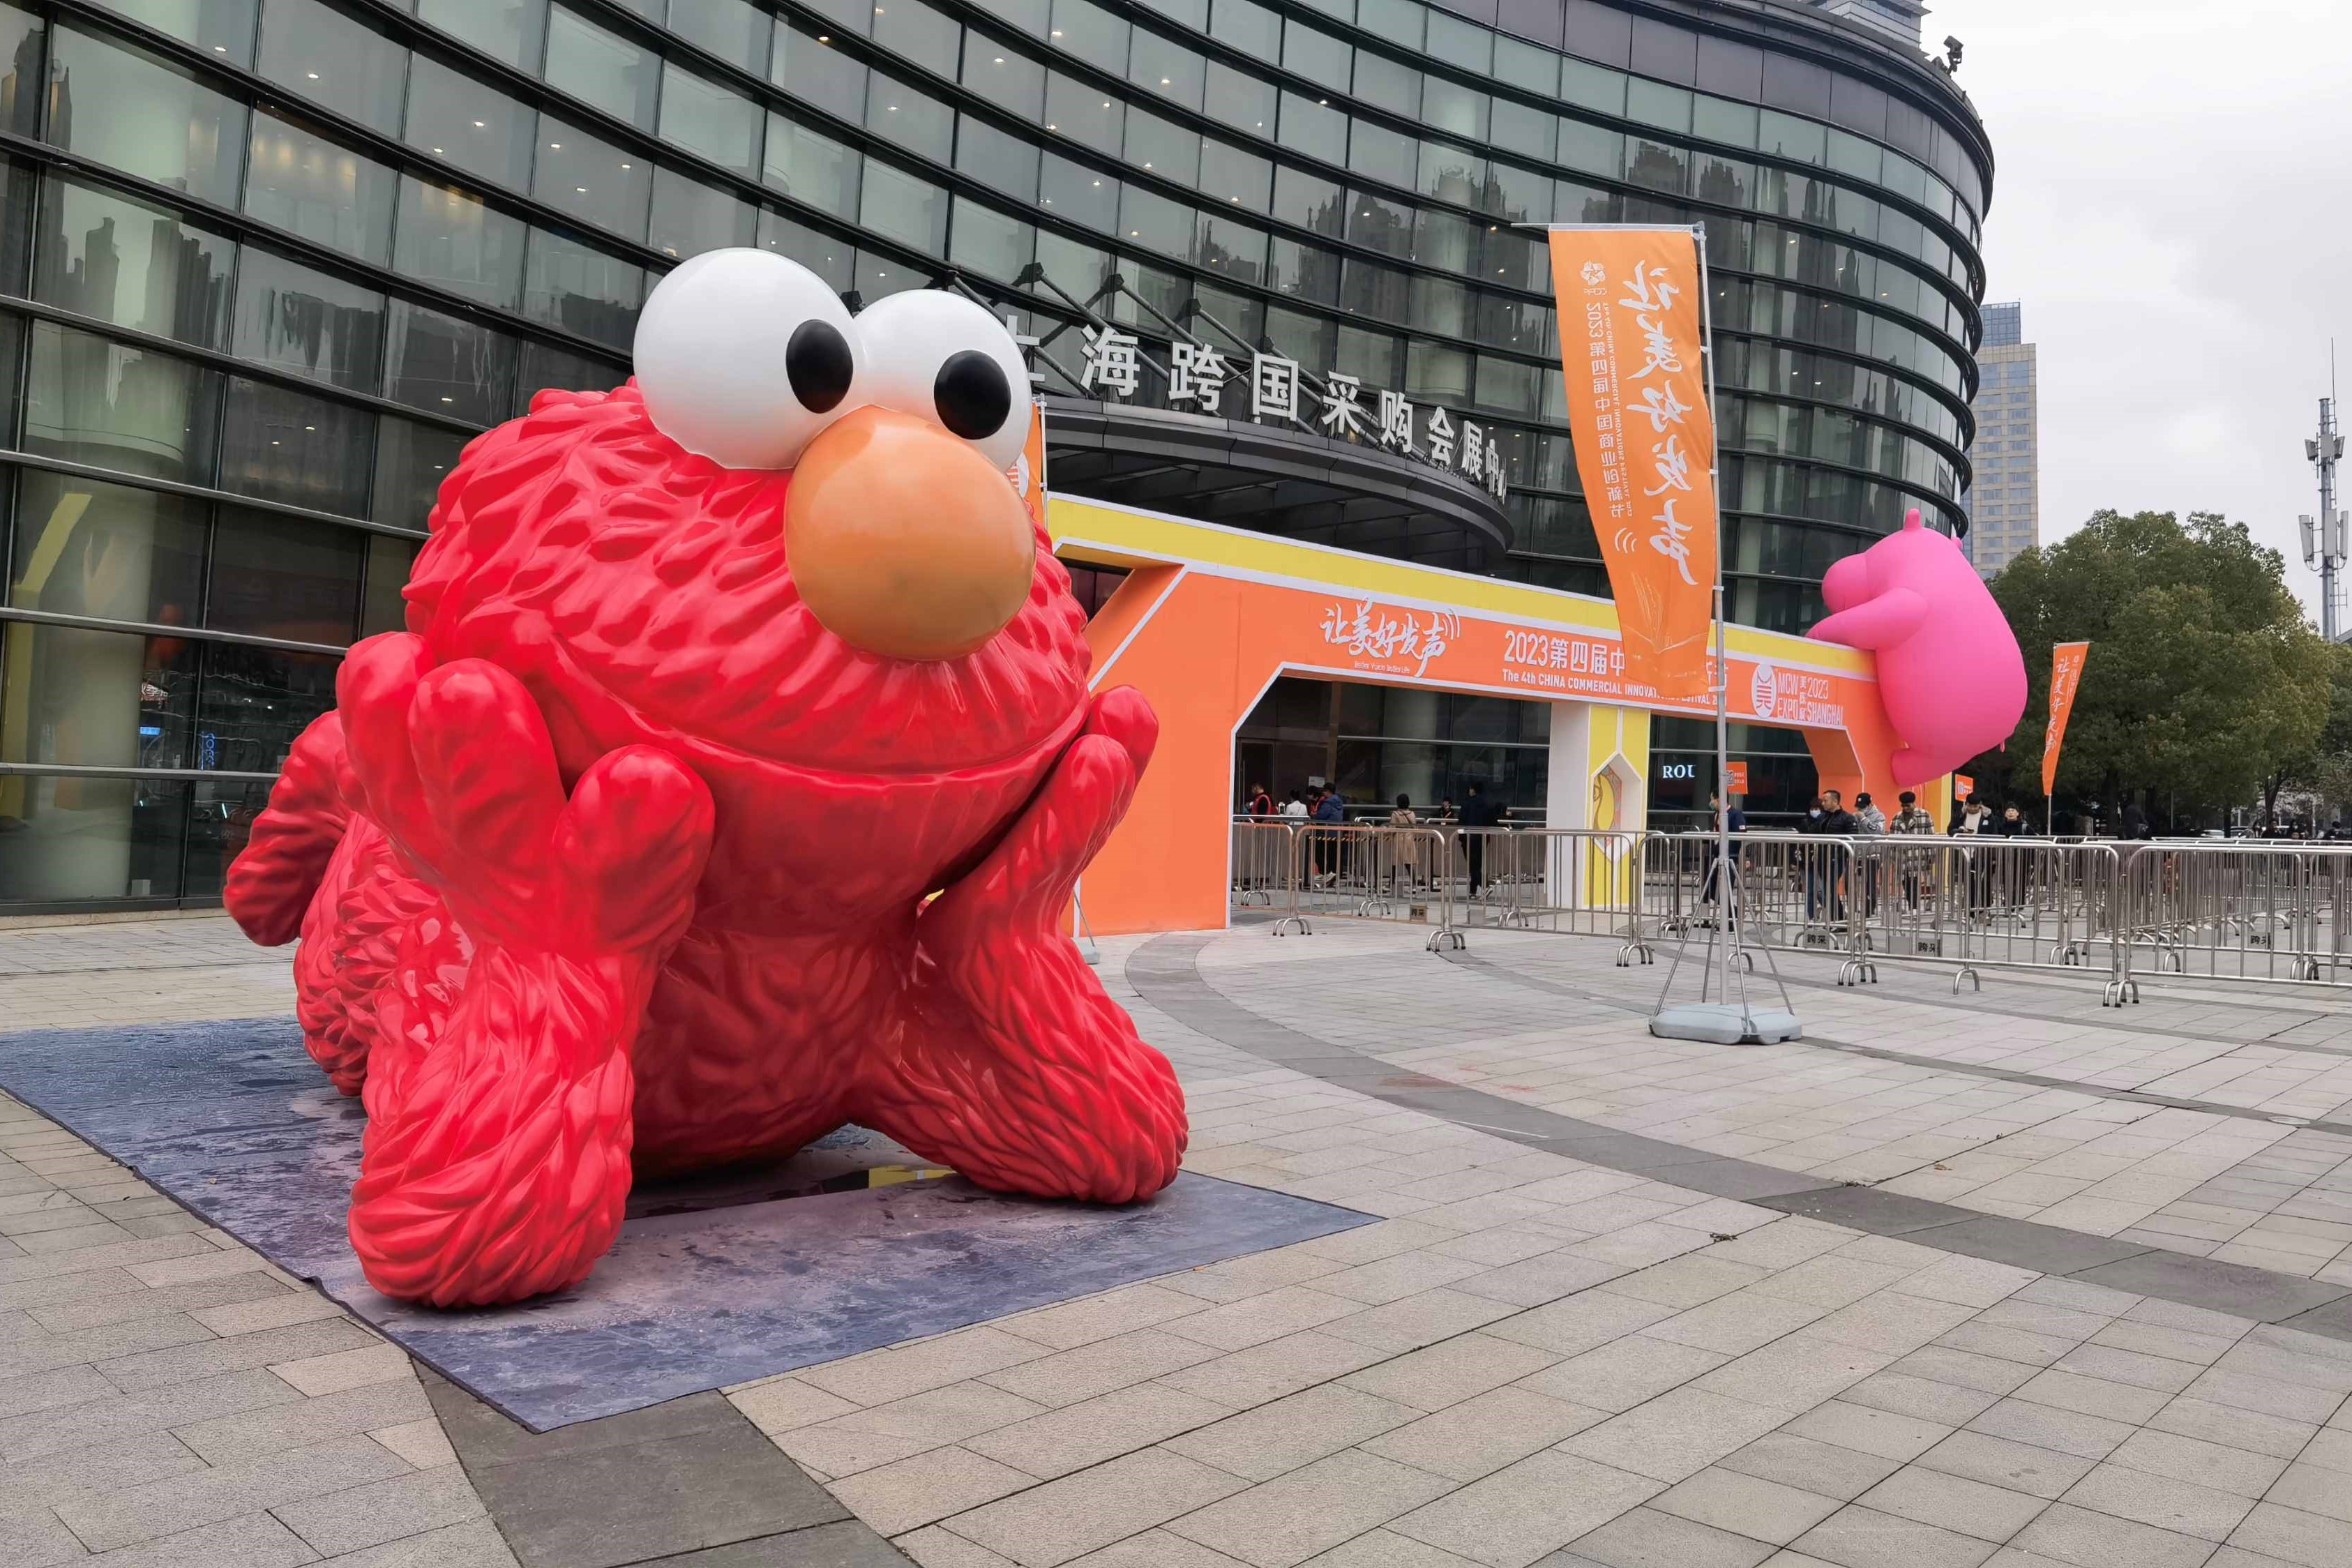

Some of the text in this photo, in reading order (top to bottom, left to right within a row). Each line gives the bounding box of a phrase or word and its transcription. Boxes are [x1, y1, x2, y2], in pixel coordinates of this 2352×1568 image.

[1320, 597, 1446, 677] 让美好发声
[1502, 668, 1519, 682] The
[1521, 671, 1536, 685] 4th
[1538, 673, 1566, 688] CHINA
[1568, 677, 1622, 694] COMMERCIAL
[1778, 672, 1799, 695] MCW
[1807, 677, 1829, 700] 2023
[1777, 697, 1798, 720] EXPO
[1807, 702, 1844, 726] SHANGHAI
